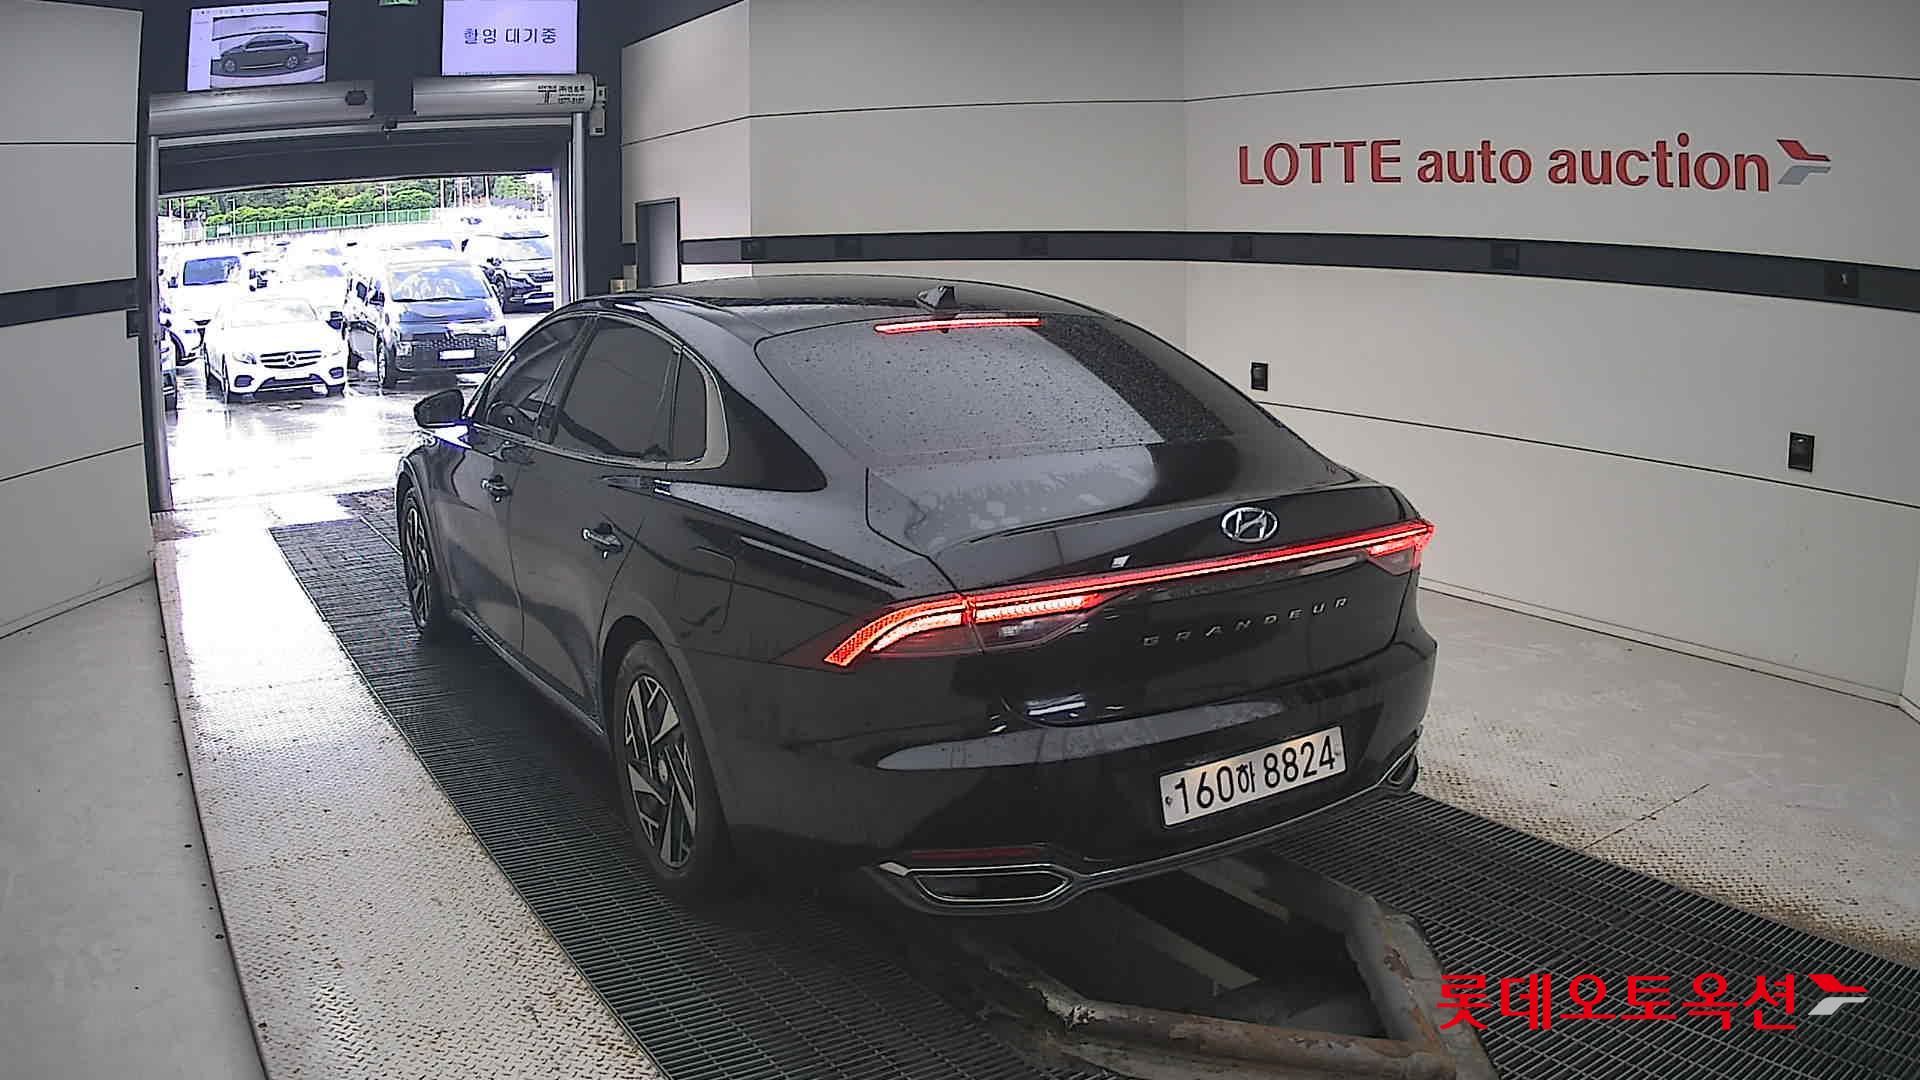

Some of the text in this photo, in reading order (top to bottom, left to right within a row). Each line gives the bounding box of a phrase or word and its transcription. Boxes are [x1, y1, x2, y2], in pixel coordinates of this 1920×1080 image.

[505, 28, 557, 44] 대기중
[1239, 132, 1770, 192] LOTTE auto auction
[1143, 597, 1347, 646] GRANDEUR
[1174, 735, 1335, 814] 160하 8824
